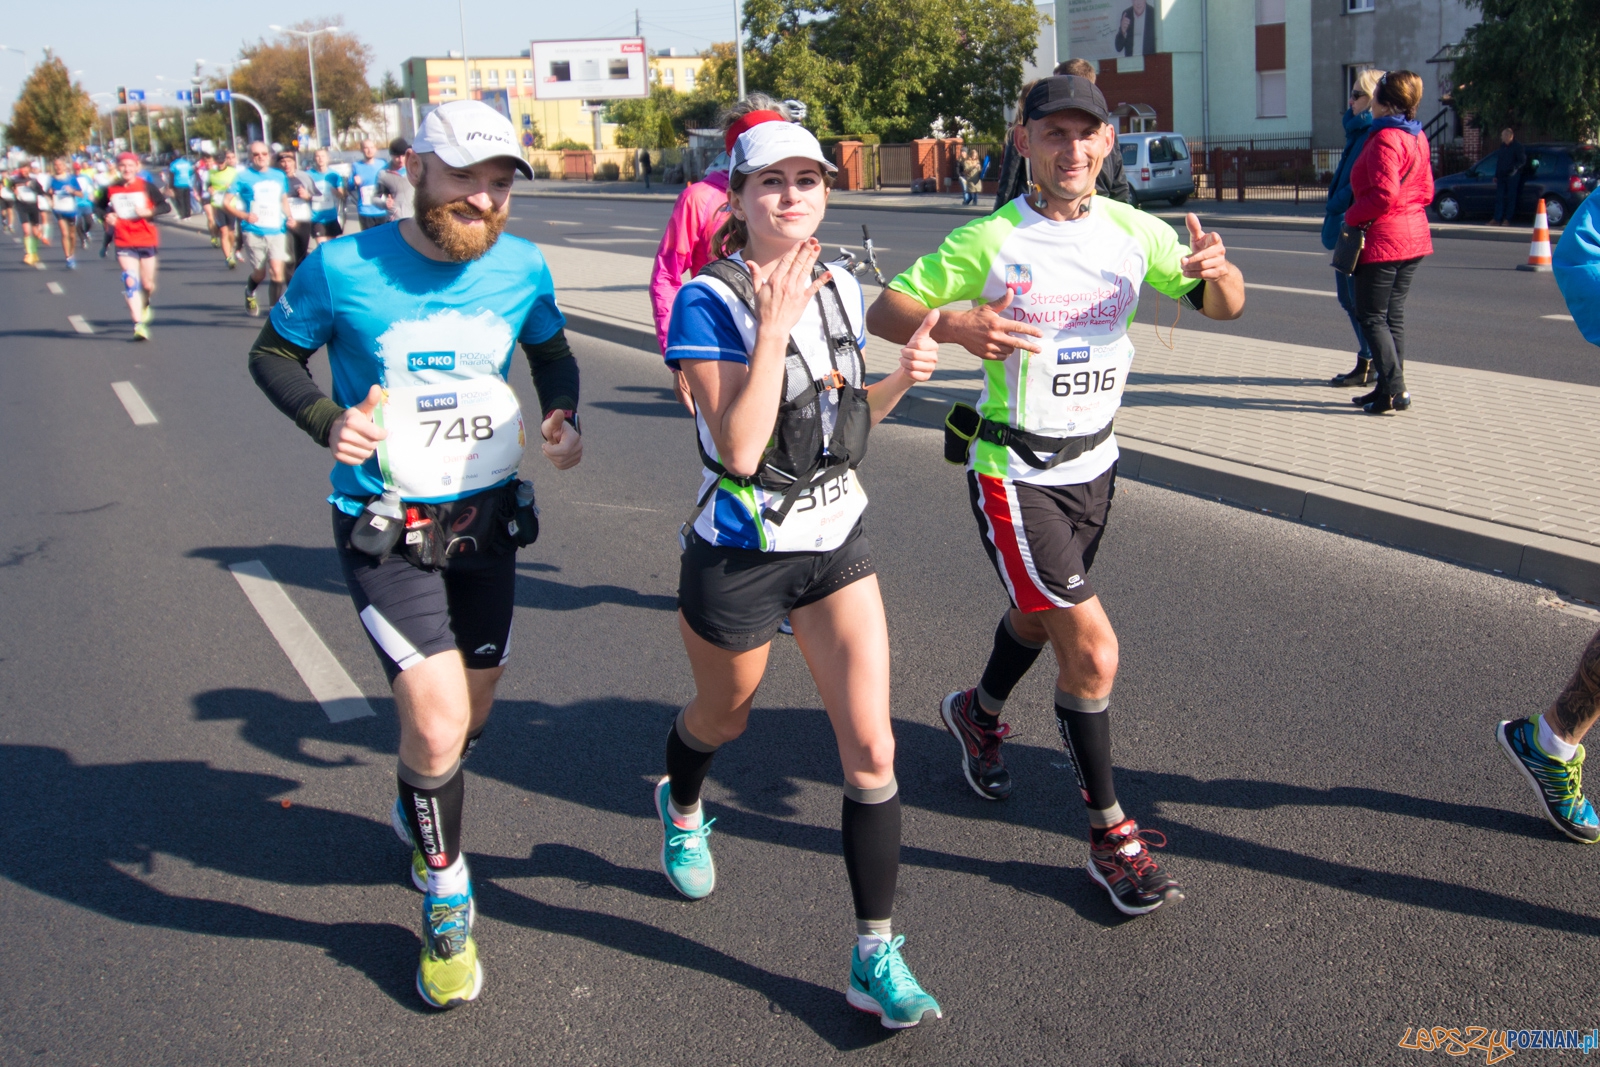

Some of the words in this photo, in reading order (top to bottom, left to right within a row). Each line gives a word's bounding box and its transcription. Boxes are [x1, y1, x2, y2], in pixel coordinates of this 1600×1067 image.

[1013, 300, 1117, 324] Dwunastka
[411, 357, 426, 367] 16.
[428, 355, 452, 366] PKO
[1060, 352, 1071, 361] 16.
[1072, 350, 1088, 359] PKO
[460, 358, 495, 366] maraton
[1052, 367, 1117, 397] 6916
[419, 399, 433, 408] 16.
[434, 397, 455, 407] PKO
[419, 415, 494, 448] 748
[443, 452, 479, 464] Damian
